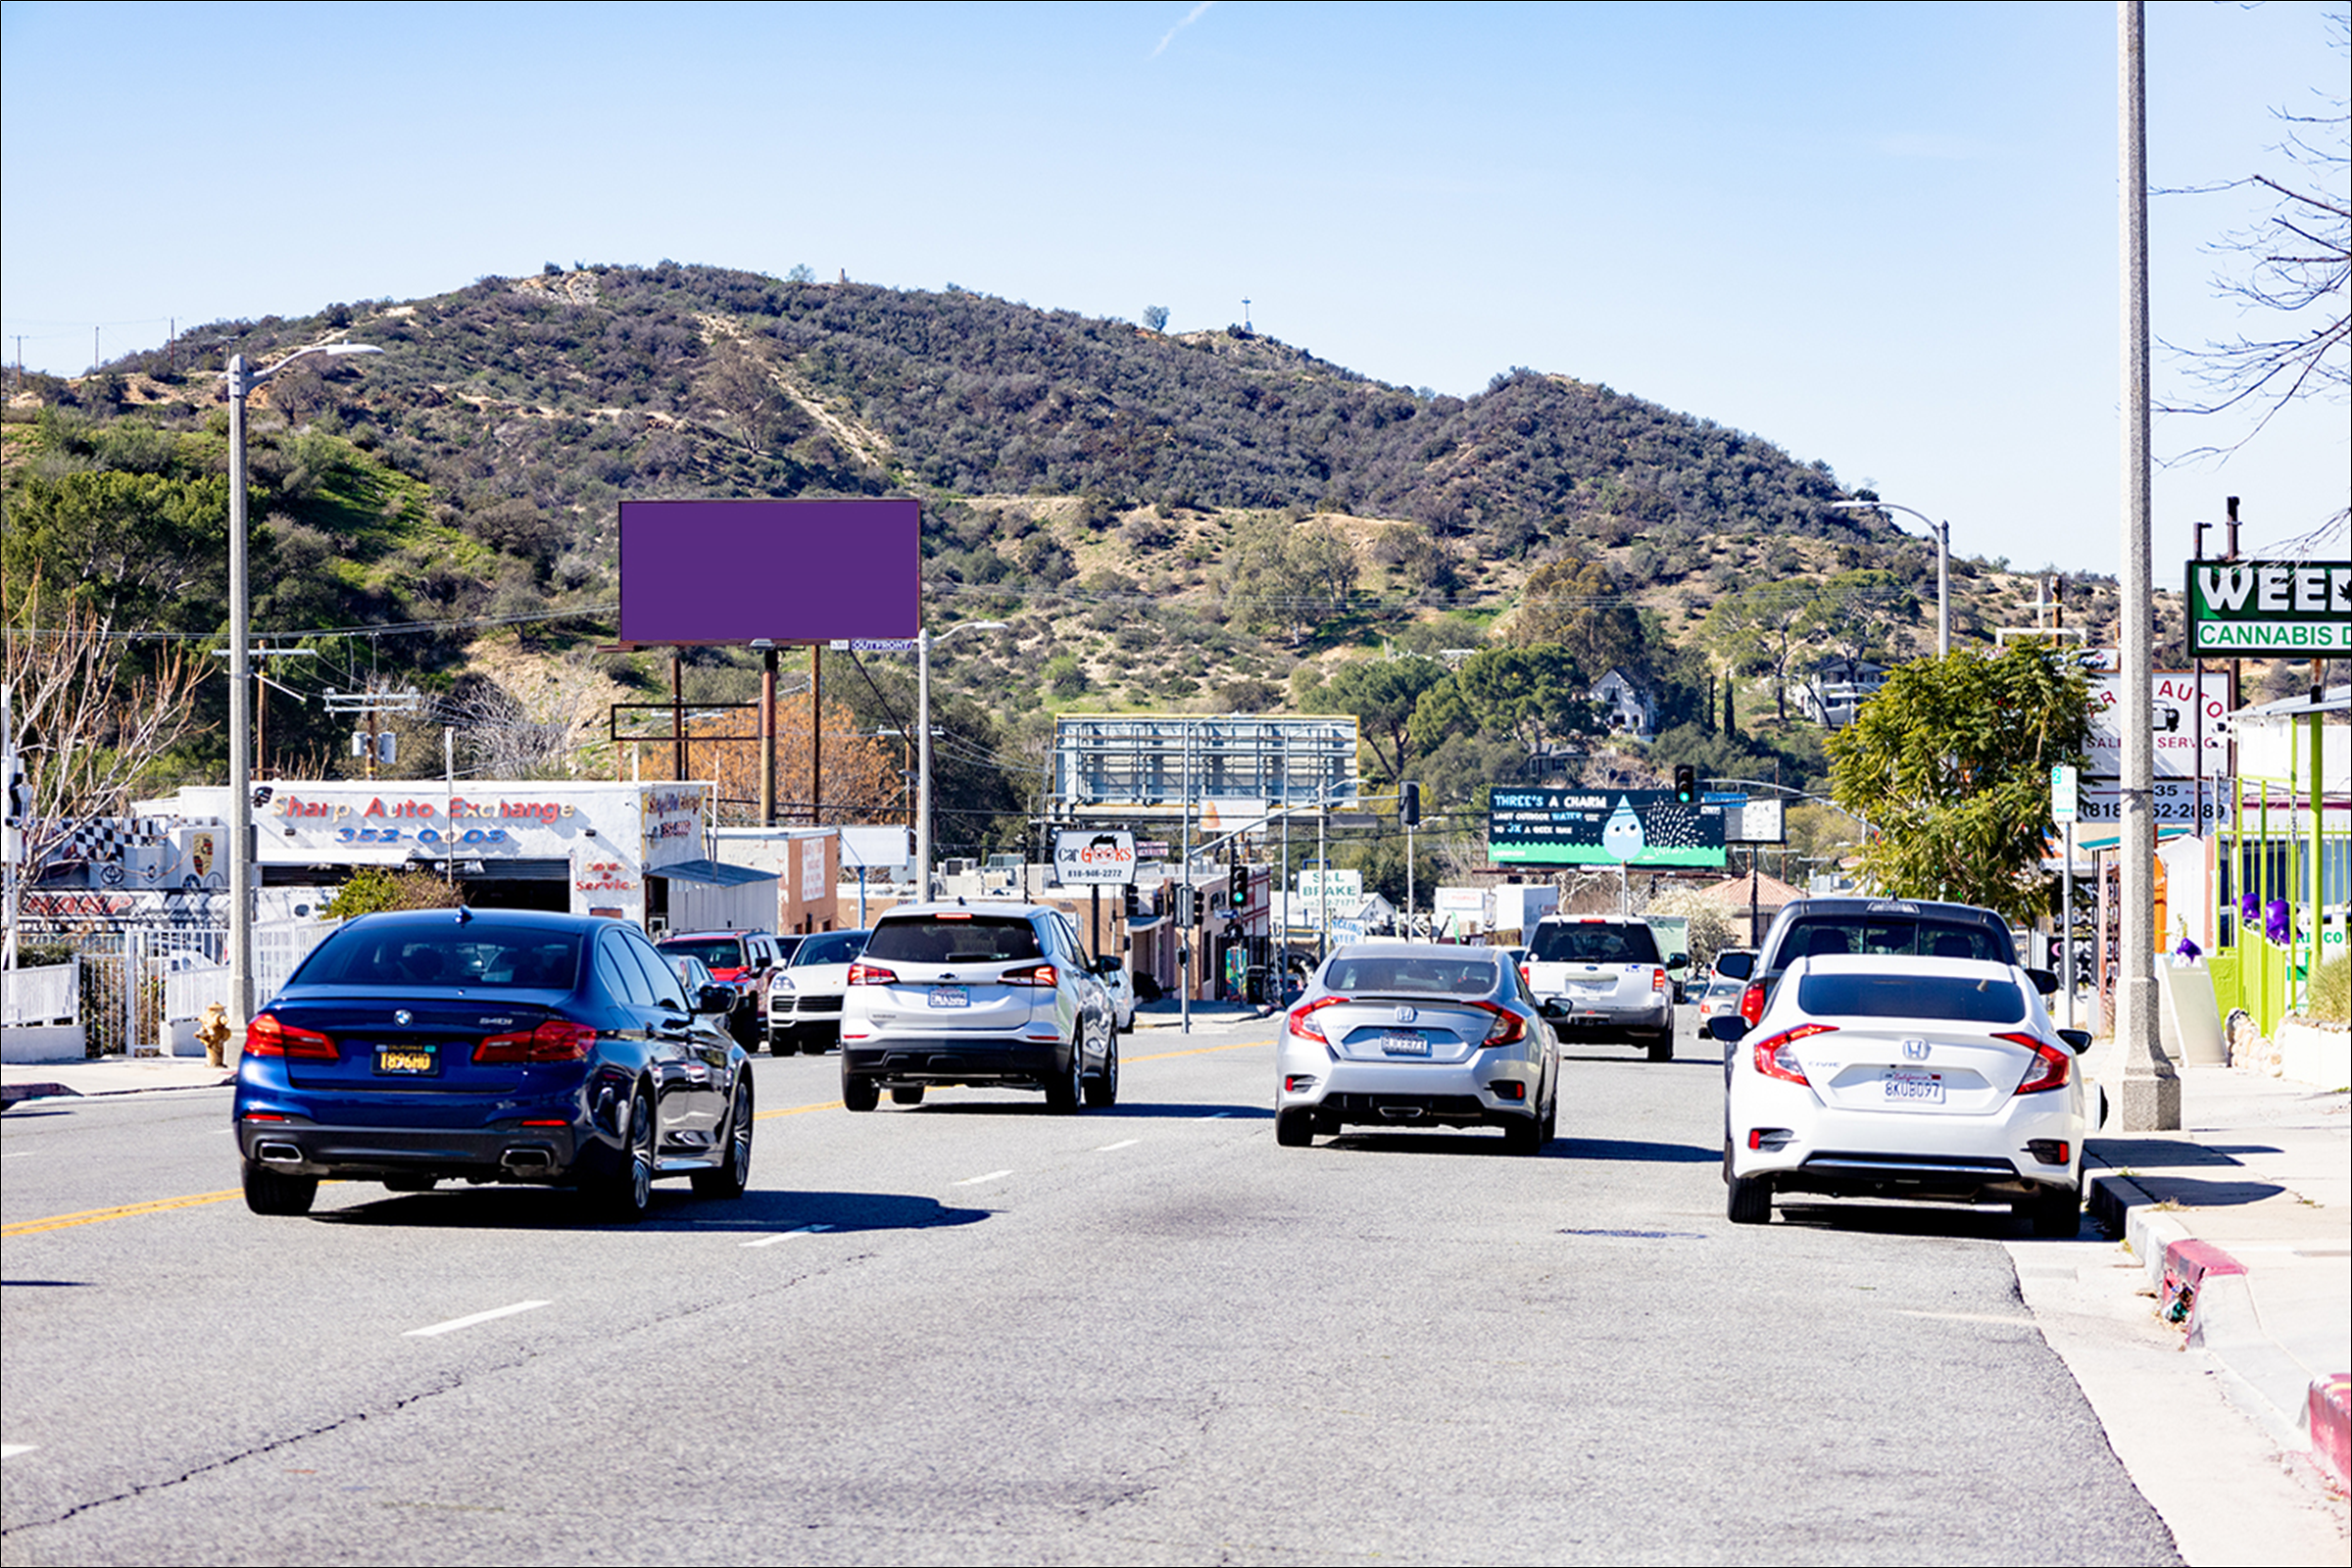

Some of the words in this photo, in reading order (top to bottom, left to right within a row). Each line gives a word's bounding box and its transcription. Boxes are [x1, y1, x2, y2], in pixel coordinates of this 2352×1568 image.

[2199, 625, 2333, 645] CANNABIS
[2158, 737, 2224, 749] SERVC
[1494, 795, 1544, 808] THREE'S
[1548, 795, 1559, 808] A
[1564, 796, 1607, 808] CHARM
[271, 796, 351, 823] Sharp
[364, 797, 434, 818] Auto
[446, 796, 575, 824] Exchange
[2153, 803, 2225, 818] 52-289
[1551, 811, 1583, 822] WATER
[1335, 872, 1345, 882] L
[575, 879, 638, 891] Service
[1302, 886, 1356, 896] BRAKE
